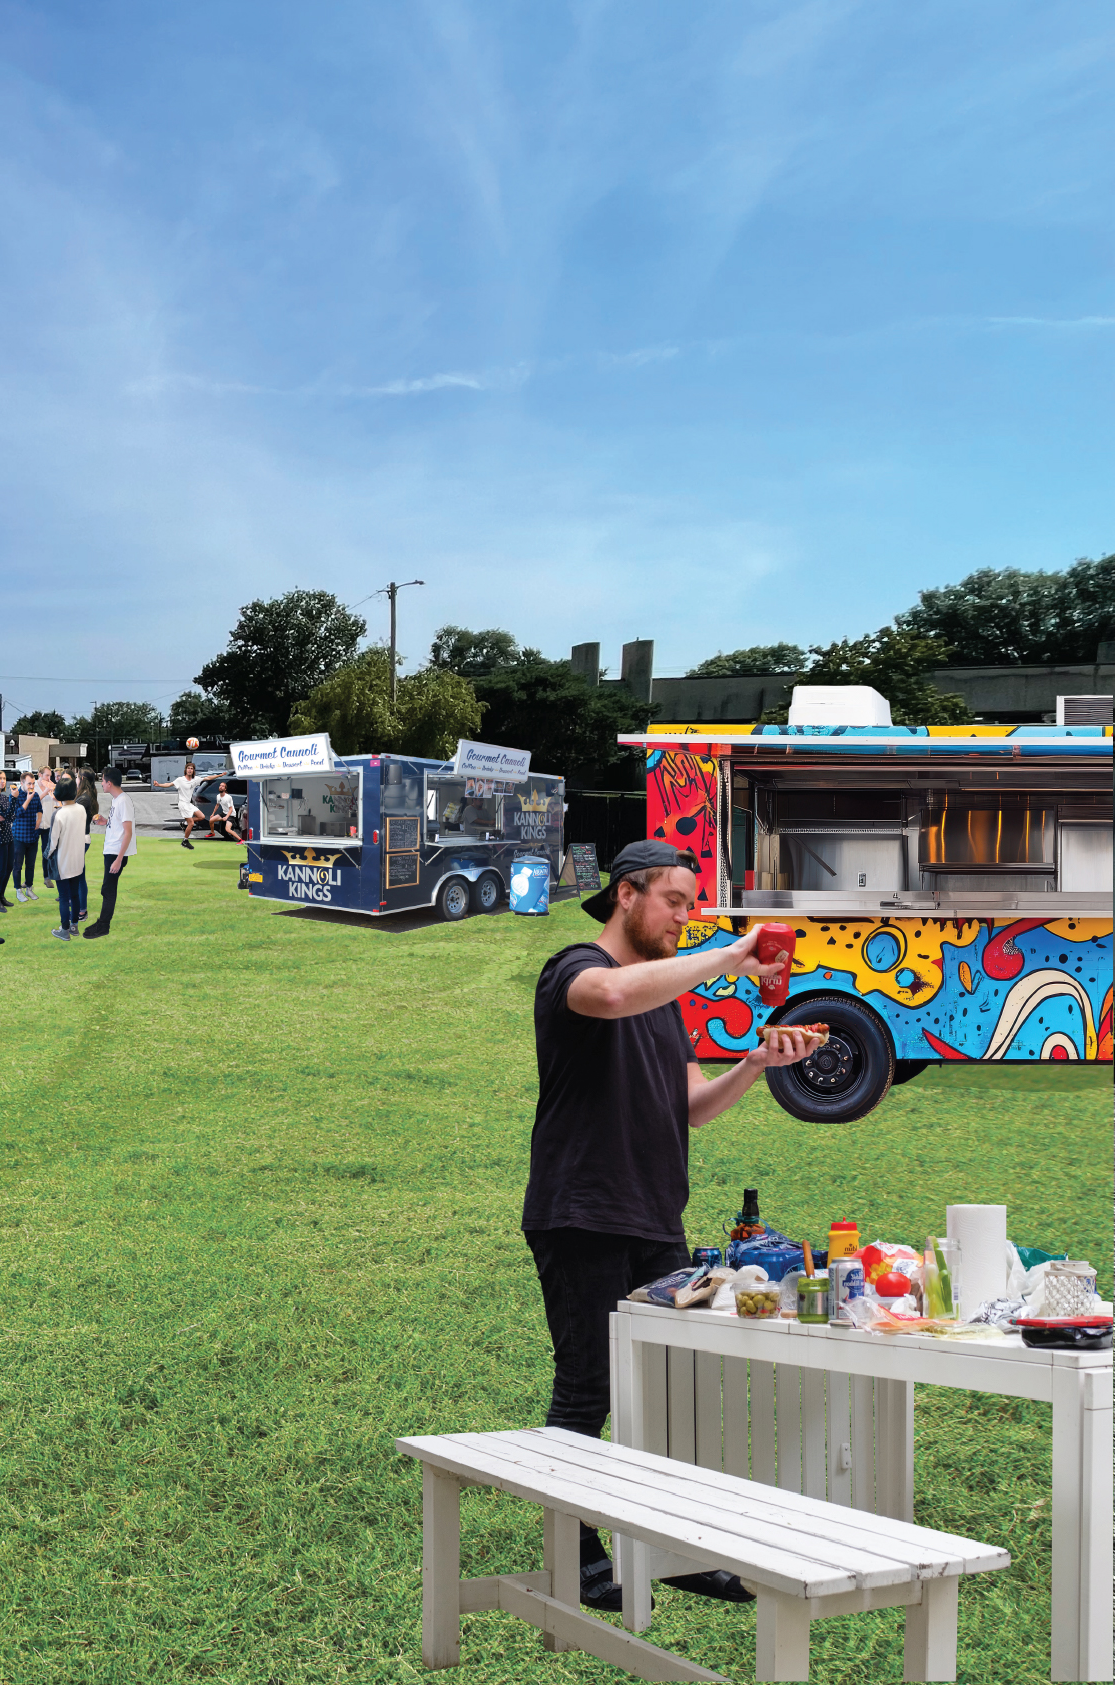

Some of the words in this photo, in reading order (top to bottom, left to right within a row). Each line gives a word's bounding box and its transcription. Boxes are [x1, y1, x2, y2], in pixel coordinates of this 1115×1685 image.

[238, 747, 278, 763] Gourmet
[280, 743, 319, 759] Cannoli
[466, 748, 501, 764] Gourmet
[500, 754, 527, 767] Cannoli
[282, 760, 303, 768] Dessert
[310, 758, 325, 766] Food
[513, 811, 552, 826] KANNOLI
[520, 826, 547, 840] KINGS
[278, 865, 341, 886] KANNOLI
[289, 882, 331, 901] KINGS
